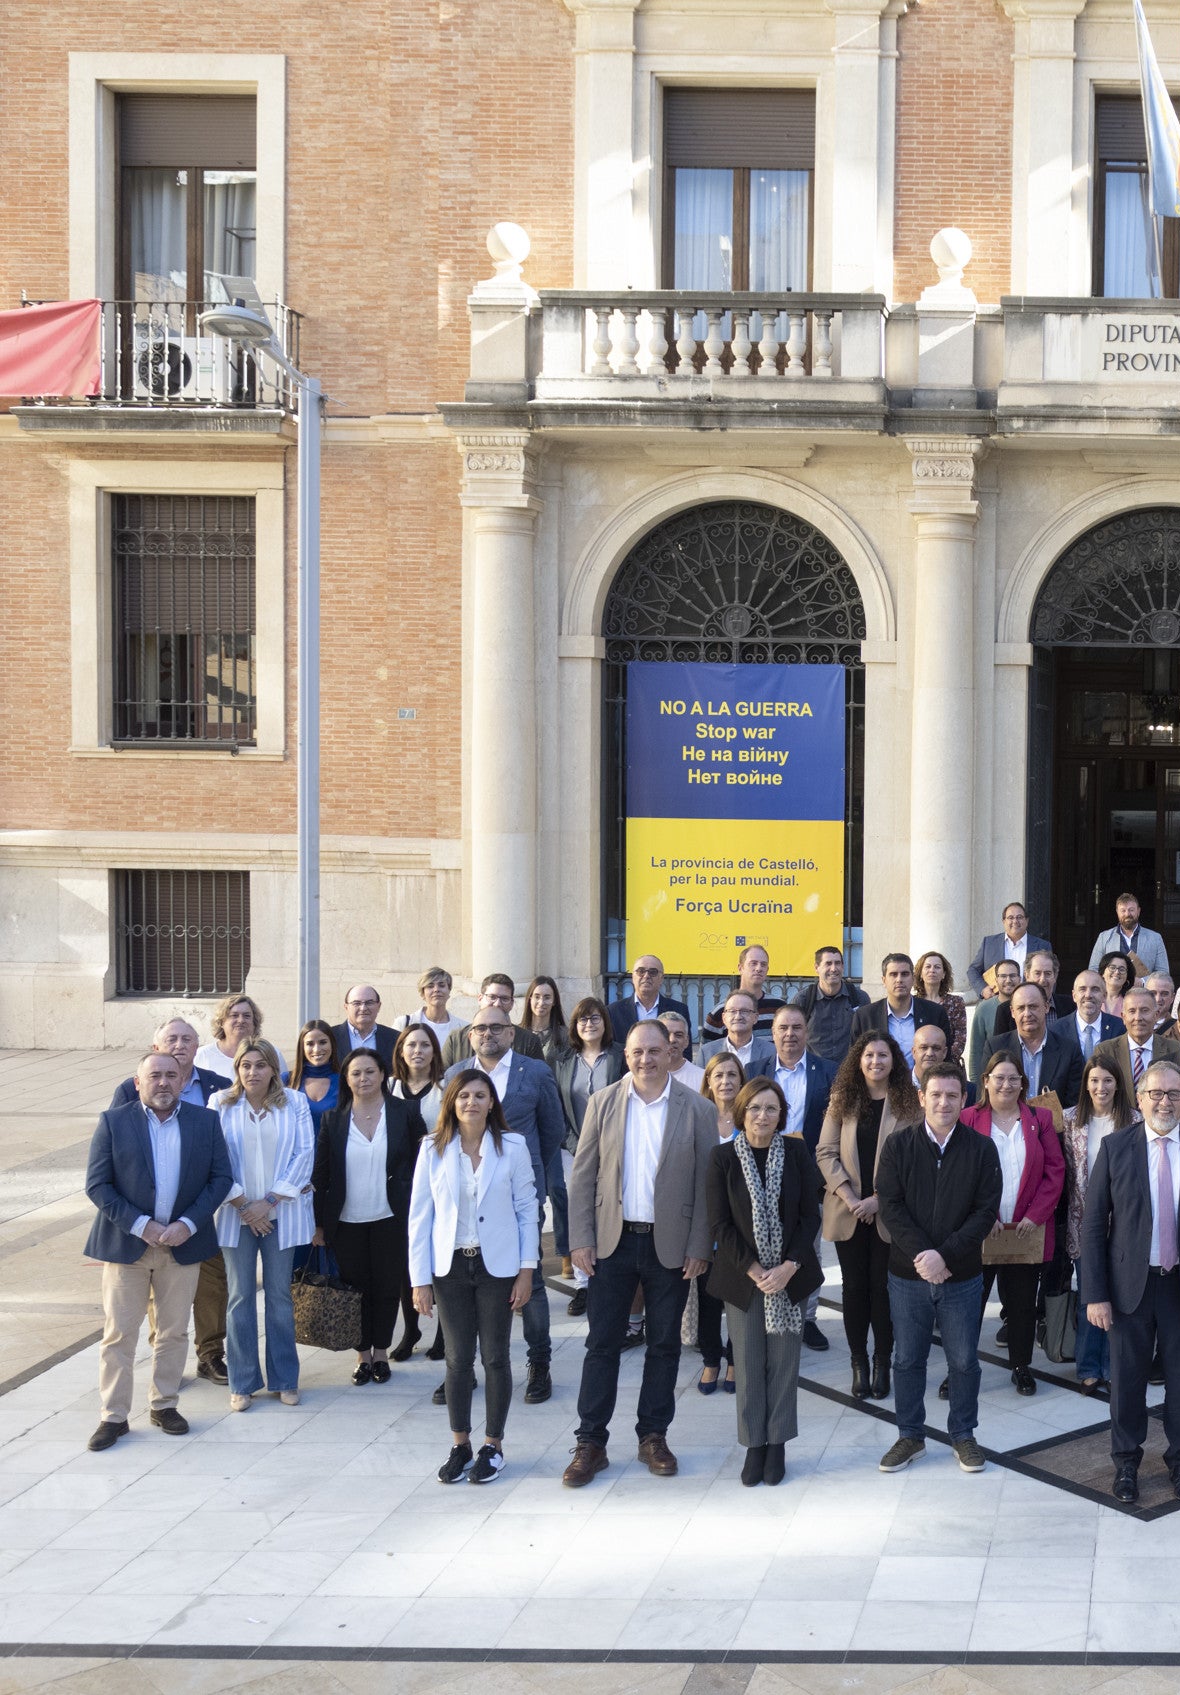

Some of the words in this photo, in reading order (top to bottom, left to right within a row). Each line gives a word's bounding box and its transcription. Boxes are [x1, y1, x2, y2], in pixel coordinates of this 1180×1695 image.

[660, 700, 686, 716] NO
[691, 701, 703, 716] A
[708, 701, 731, 716] LA
[736, 701, 813, 717] GUERRA
[695, 722, 737, 742] Stop
[743, 727, 776, 740] war
[682, 745, 706, 762] Не
[712, 749, 733, 762] на
[739, 747, 789, 766] війну
[688, 768, 721, 785] Нет
[726, 769, 783, 785] войне
[651, 856, 667, 868] La
[671, 857, 734, 871] província
[738, 857, 755, 869] de
[759, 858, 819, 871] Castelló,
[669, 875, 692, 887] per
[695, 874, 707, 885] la
[711, 876, 736, 888] pau
[740, 874, 799, 886] mundial.
[676, 898, 723, 916] Força
[728, 899, 793, 914] Ucraïna
